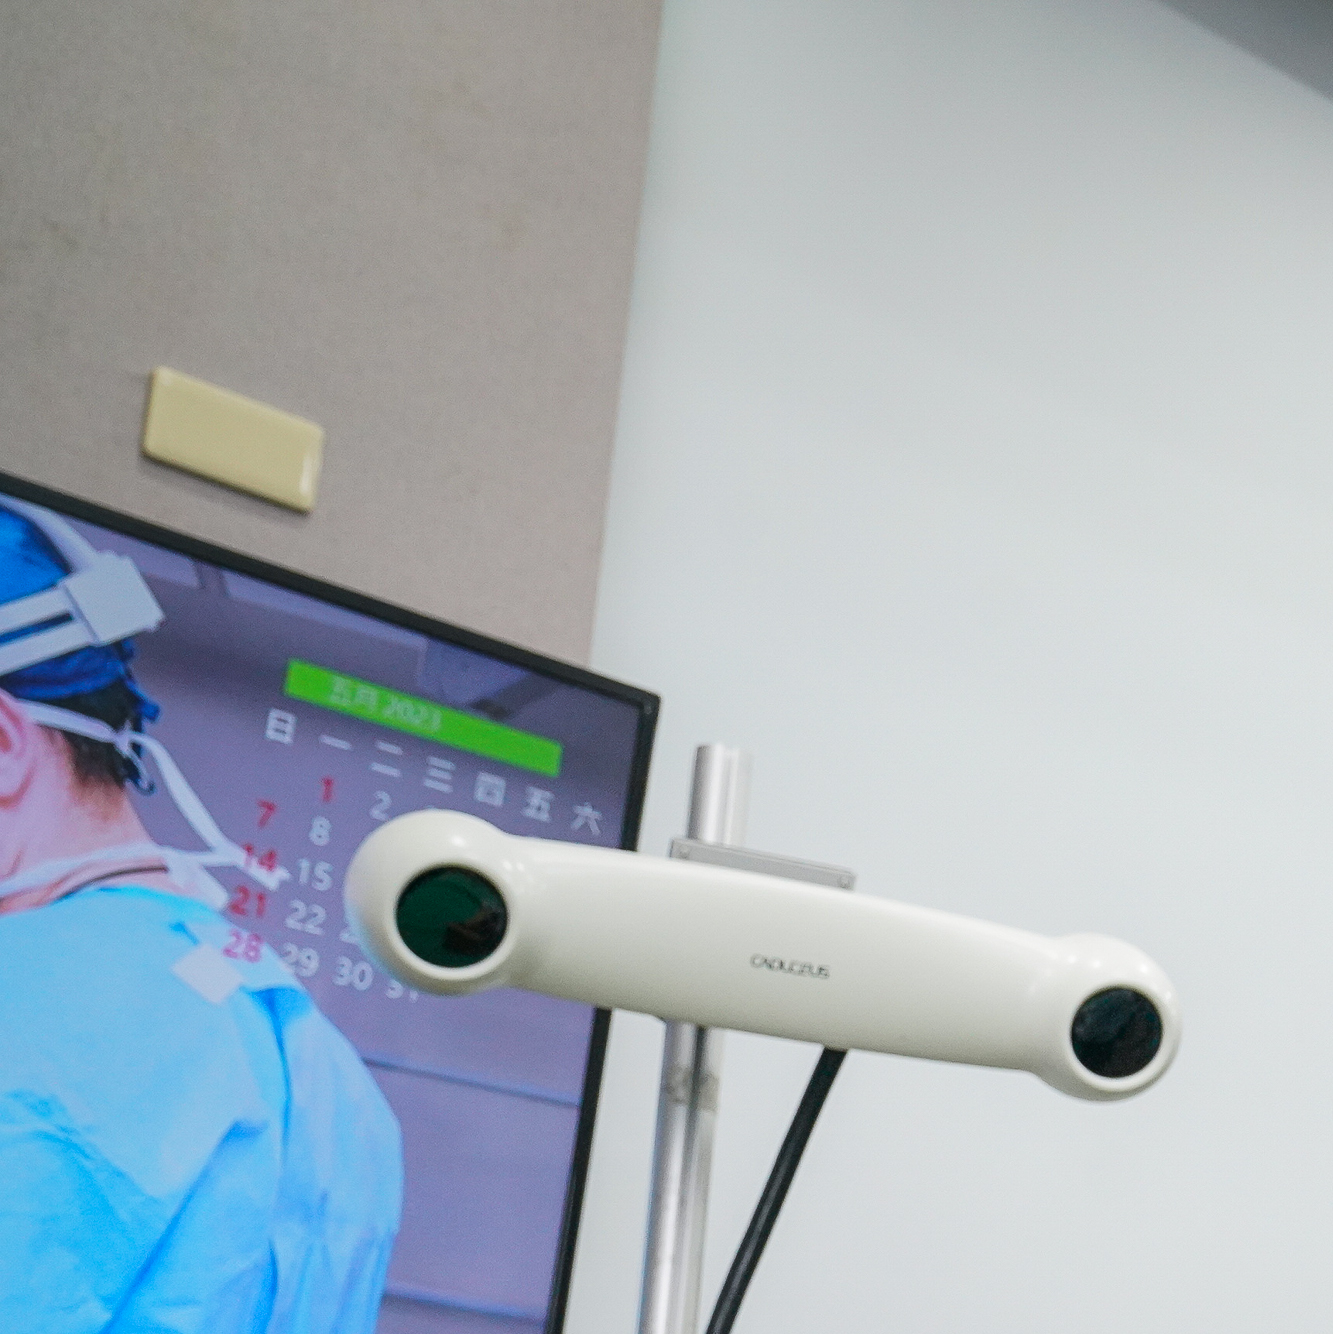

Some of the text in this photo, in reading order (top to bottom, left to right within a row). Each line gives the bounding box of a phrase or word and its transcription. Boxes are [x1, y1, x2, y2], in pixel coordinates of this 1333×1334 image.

[329, 674, 441, 733] 五月 2023
[265, 707, 602, 836] 日 一 二 三 四 五 六
[256, 799, 332, 848] 7 8
[321, 775, 393, 822] 1 2
[243, 843, 333, 892] 14 15
[228, 885, 267, 918] 21
[285, 899, 327, 936] 22
[222, 928, 262, 964] 28
[281, 942, 320, 977] 29
[332, 956, 374, 992] 30
